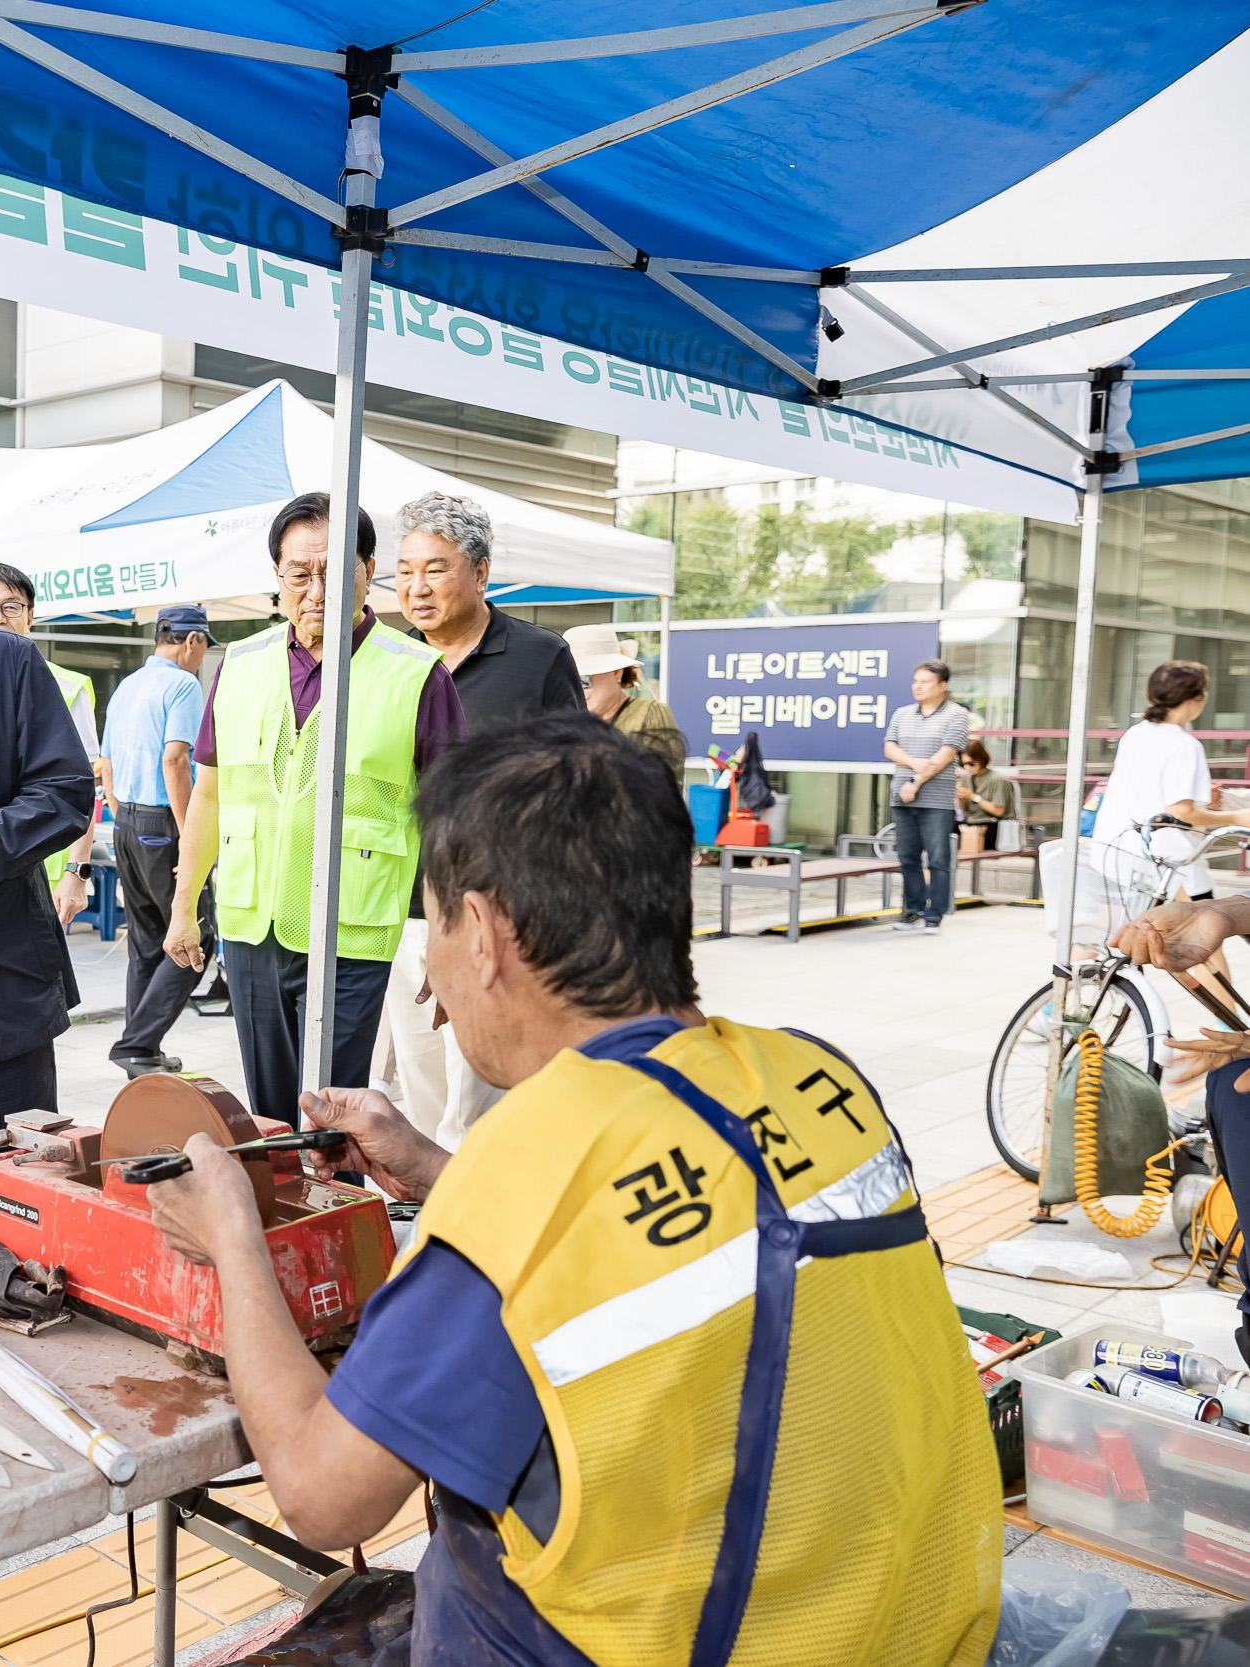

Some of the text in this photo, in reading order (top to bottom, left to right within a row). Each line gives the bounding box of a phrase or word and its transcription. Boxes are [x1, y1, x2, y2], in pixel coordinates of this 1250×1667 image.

[120, 560, 177, 593] 만들기
[707, 649, 889, 685] 나루아트센터
[705, 694, 888, 735] 엘리베이터
[26, 1209, 39, 1221] 200
